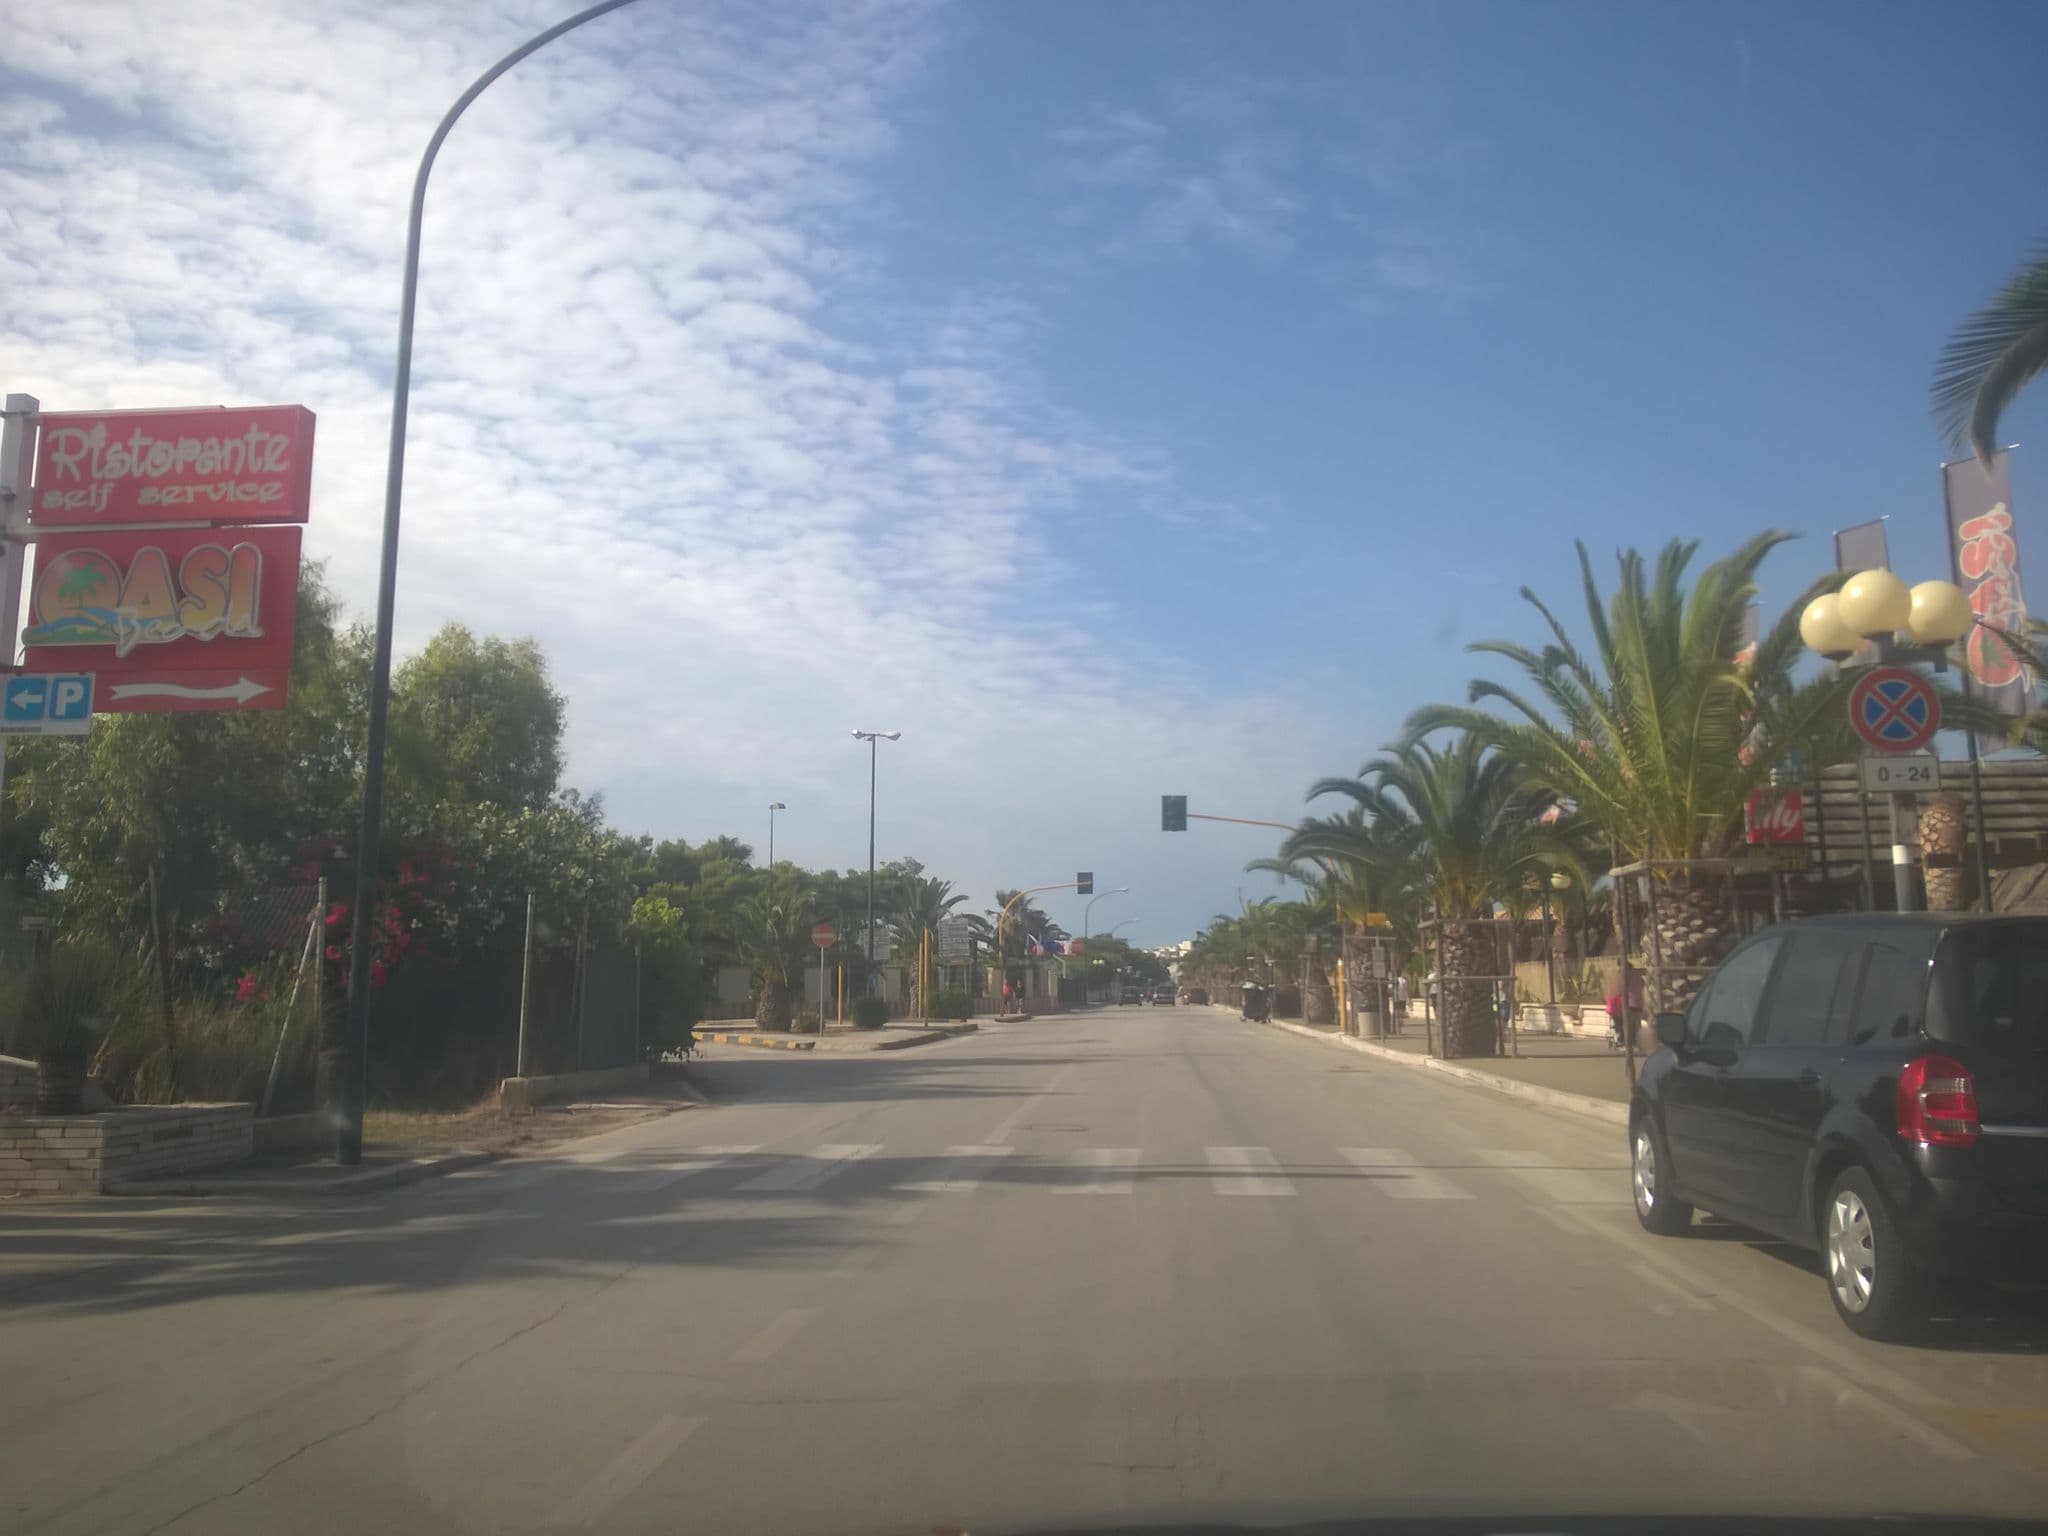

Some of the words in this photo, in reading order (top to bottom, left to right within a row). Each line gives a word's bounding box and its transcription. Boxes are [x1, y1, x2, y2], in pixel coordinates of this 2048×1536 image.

[47, 421, 290, 482] Ristorante
[42, 483, 115, 513] self
[138, 479, 285, 507] service
[36, 542, 263, 642] OASI
[56, 681, 84, 716] P
[1878, 766, 1889, 783] 0
[1908, 766, 1931, 782] 24
